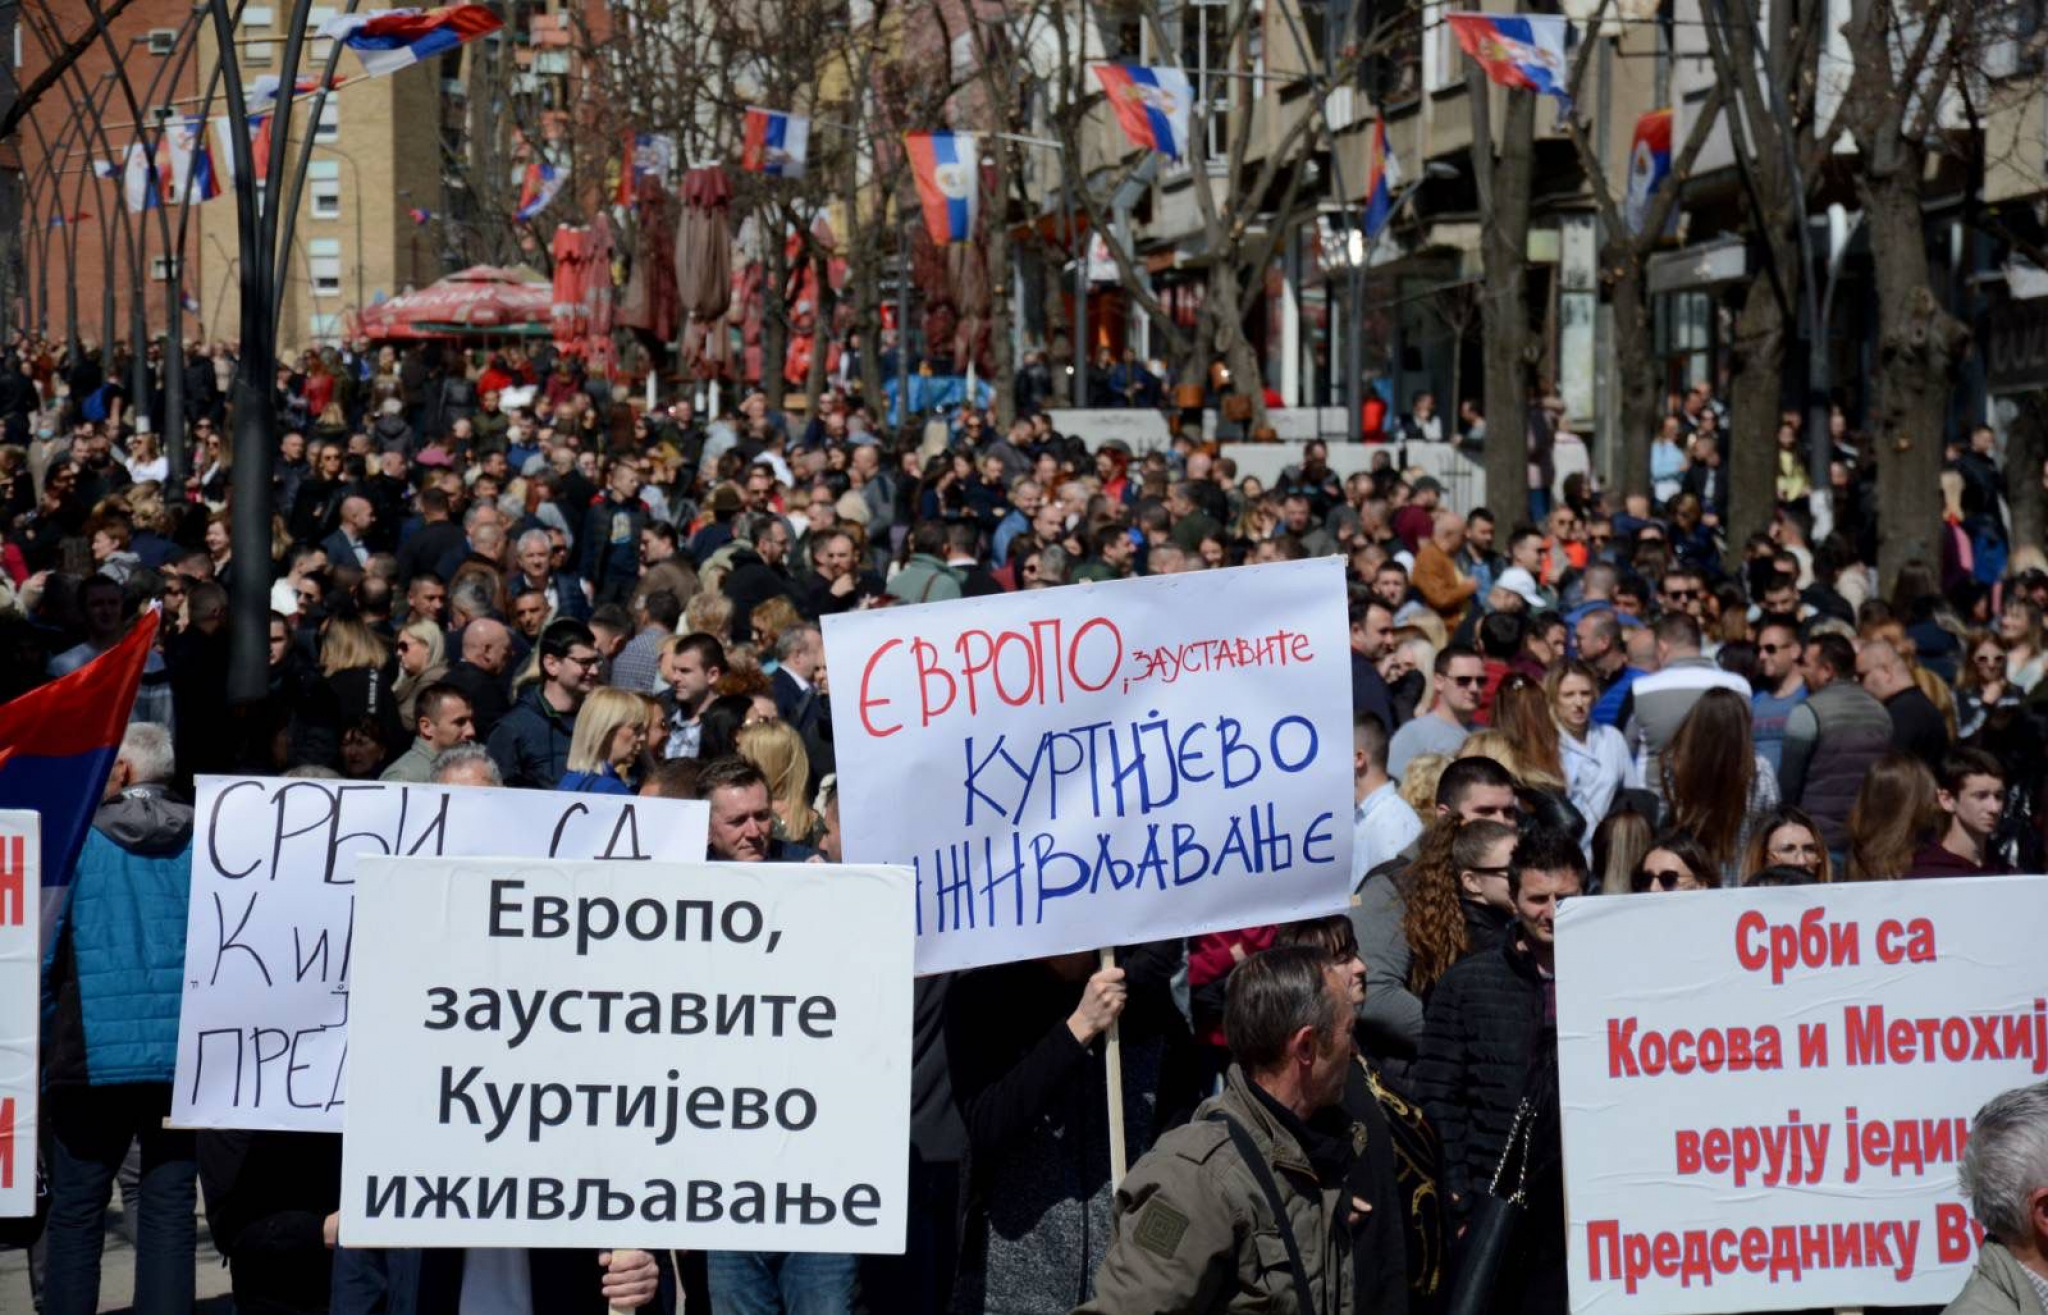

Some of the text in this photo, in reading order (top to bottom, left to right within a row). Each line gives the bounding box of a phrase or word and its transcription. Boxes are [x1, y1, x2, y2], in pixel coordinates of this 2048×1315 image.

[208, 781, 450, 884] СРБИ
[489, 878, 782, 956] Европо,
[1735, 907, 1937, 985] Срби са
[424, 985, 837, 1049] зауставите
[1607, 1018, 1783, 1077] Косова
[1798, 1023, 1828, 1067] и
[439, 1066, 817, 1145] Куртијево
[1675, 1109, 1830, 1187] верују
[365, 1175, 881, 1227] иживљавање
[1586, 1219, 1920, 1294] Председнику
